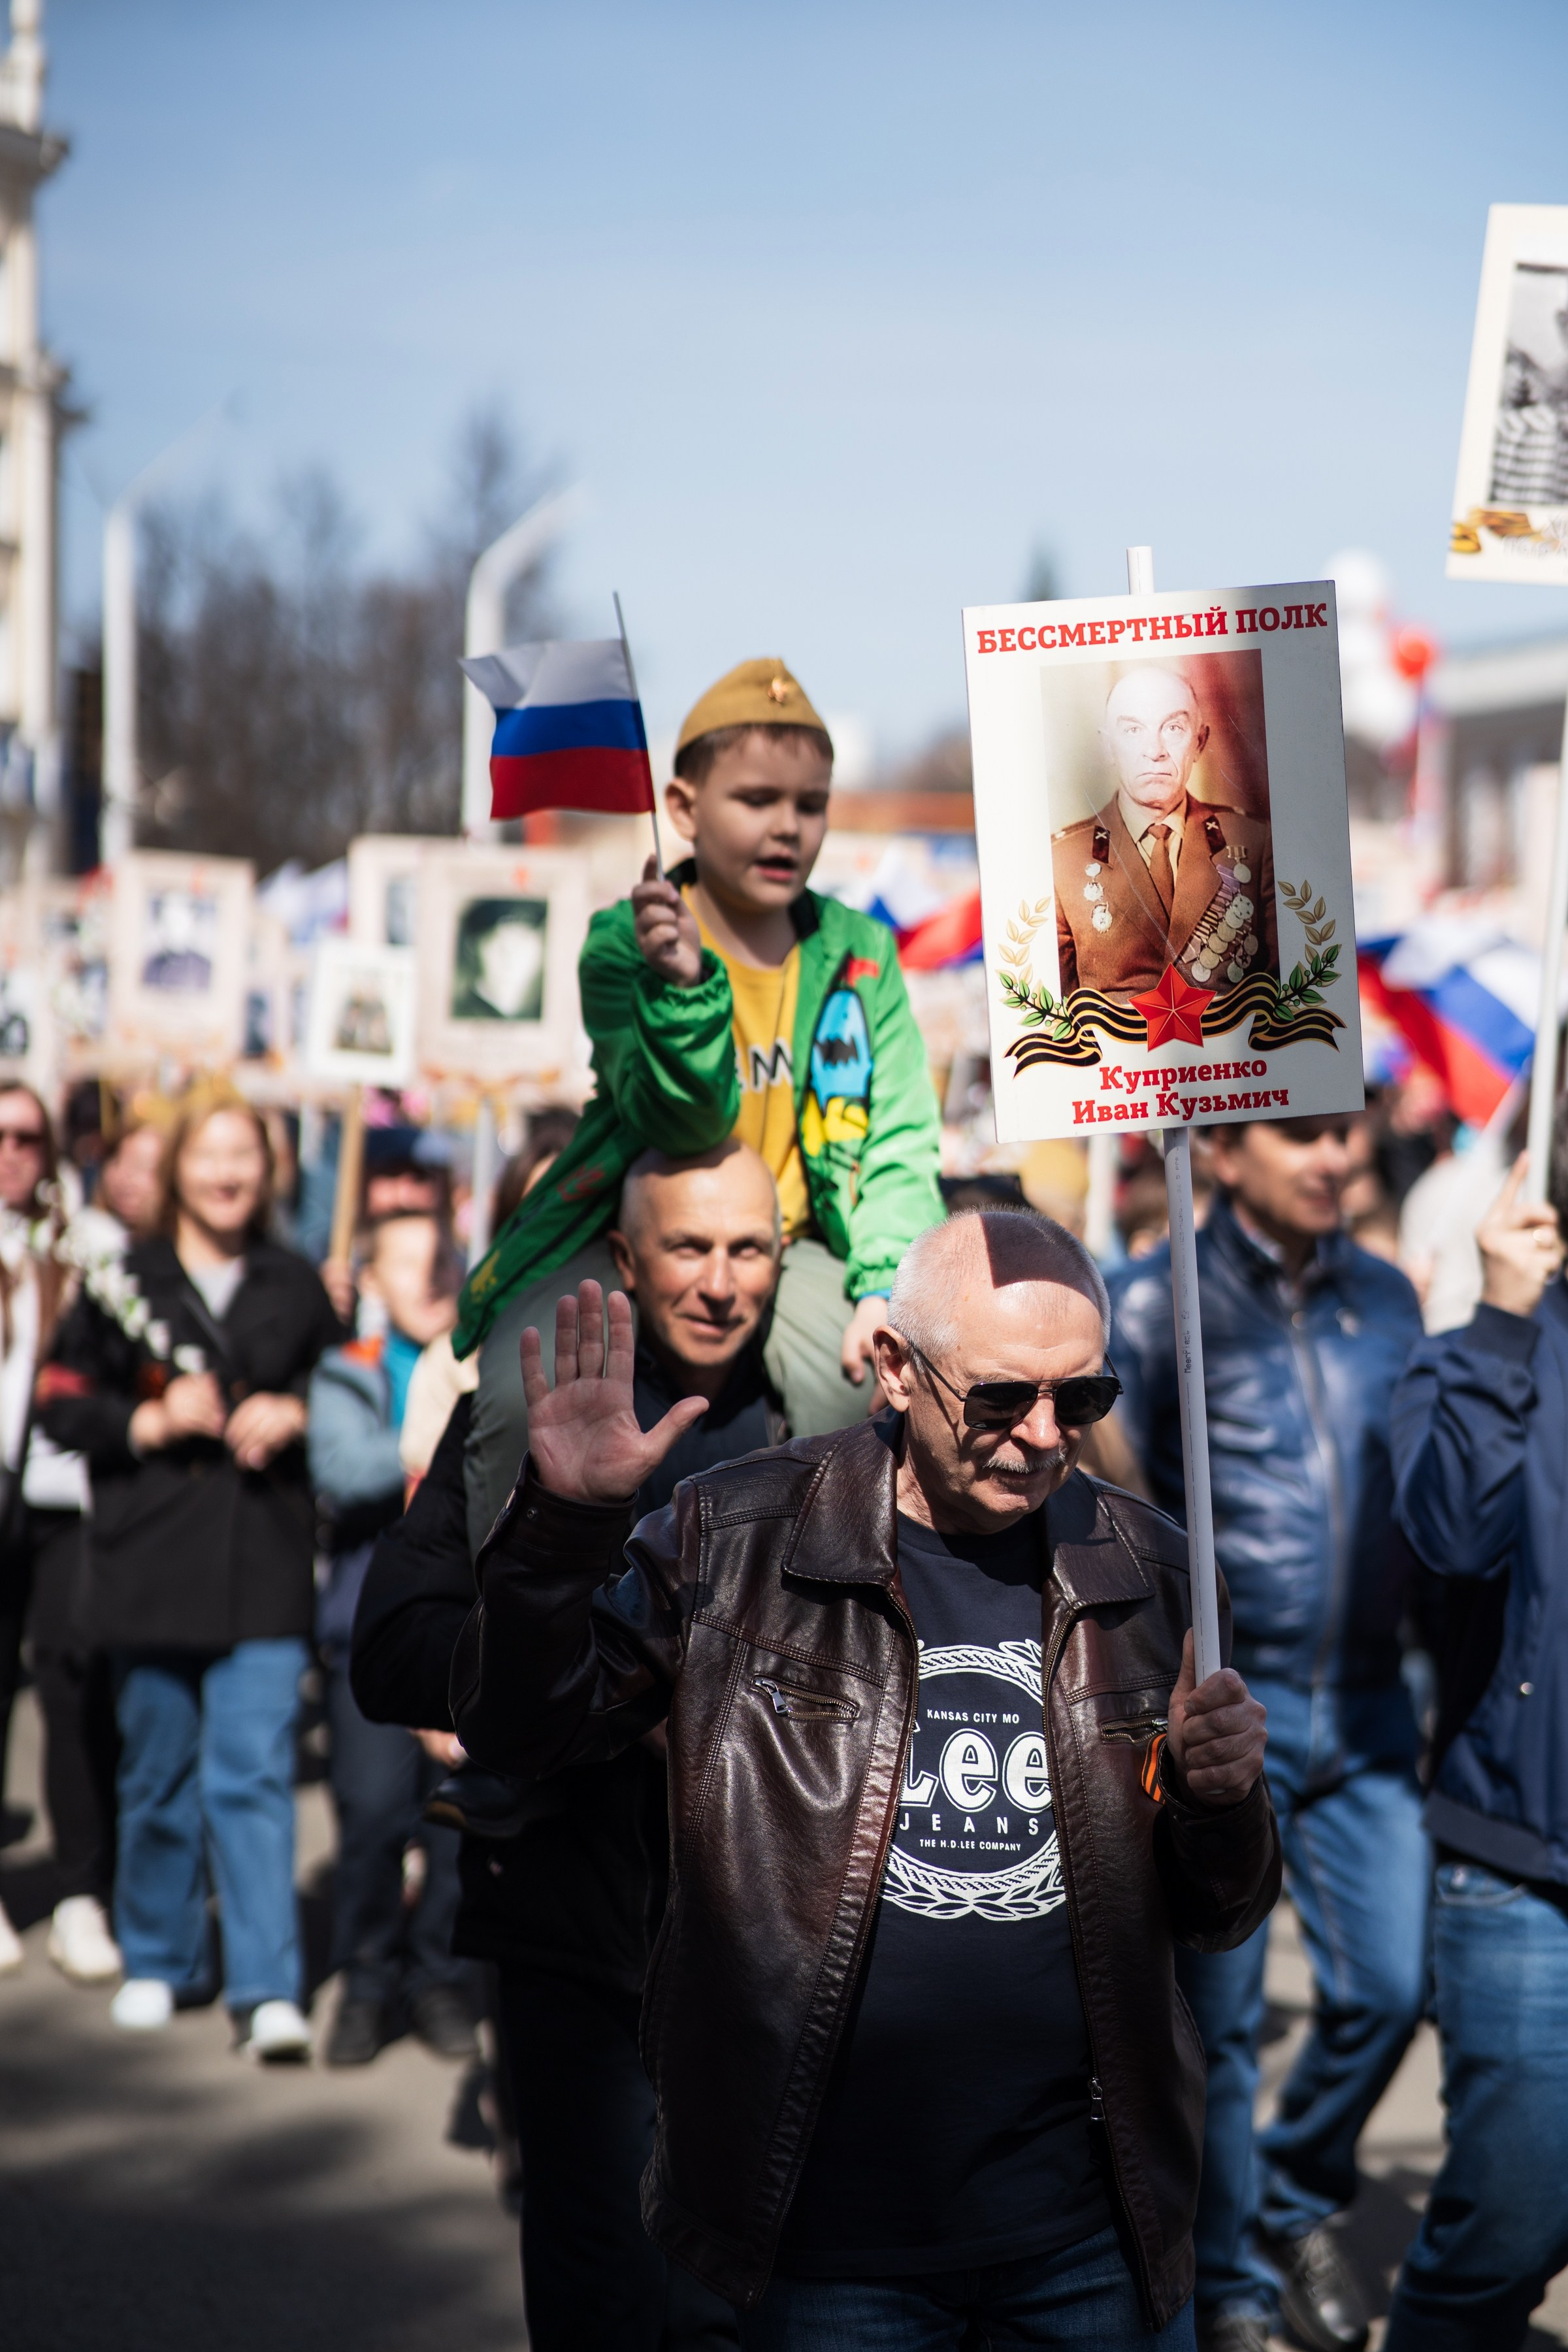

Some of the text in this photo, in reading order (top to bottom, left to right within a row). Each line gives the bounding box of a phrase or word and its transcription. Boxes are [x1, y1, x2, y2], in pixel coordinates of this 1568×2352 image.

[977, 603, 1328, 654] БЕССМЕРТНЫЙ ПОЛК
[1099, 1059, 1267, 1095] Куприенко
[1071, 1088, 1289, 1124] Иван Кузьмич
[926, 1708, 1021, 1724] KANSAS CITY MO
[899, 1812, 1039, 1835] JEANS
[919, 1838, 936, 1848] THE
[979, 1840, 1021, 1852] COMPANY
